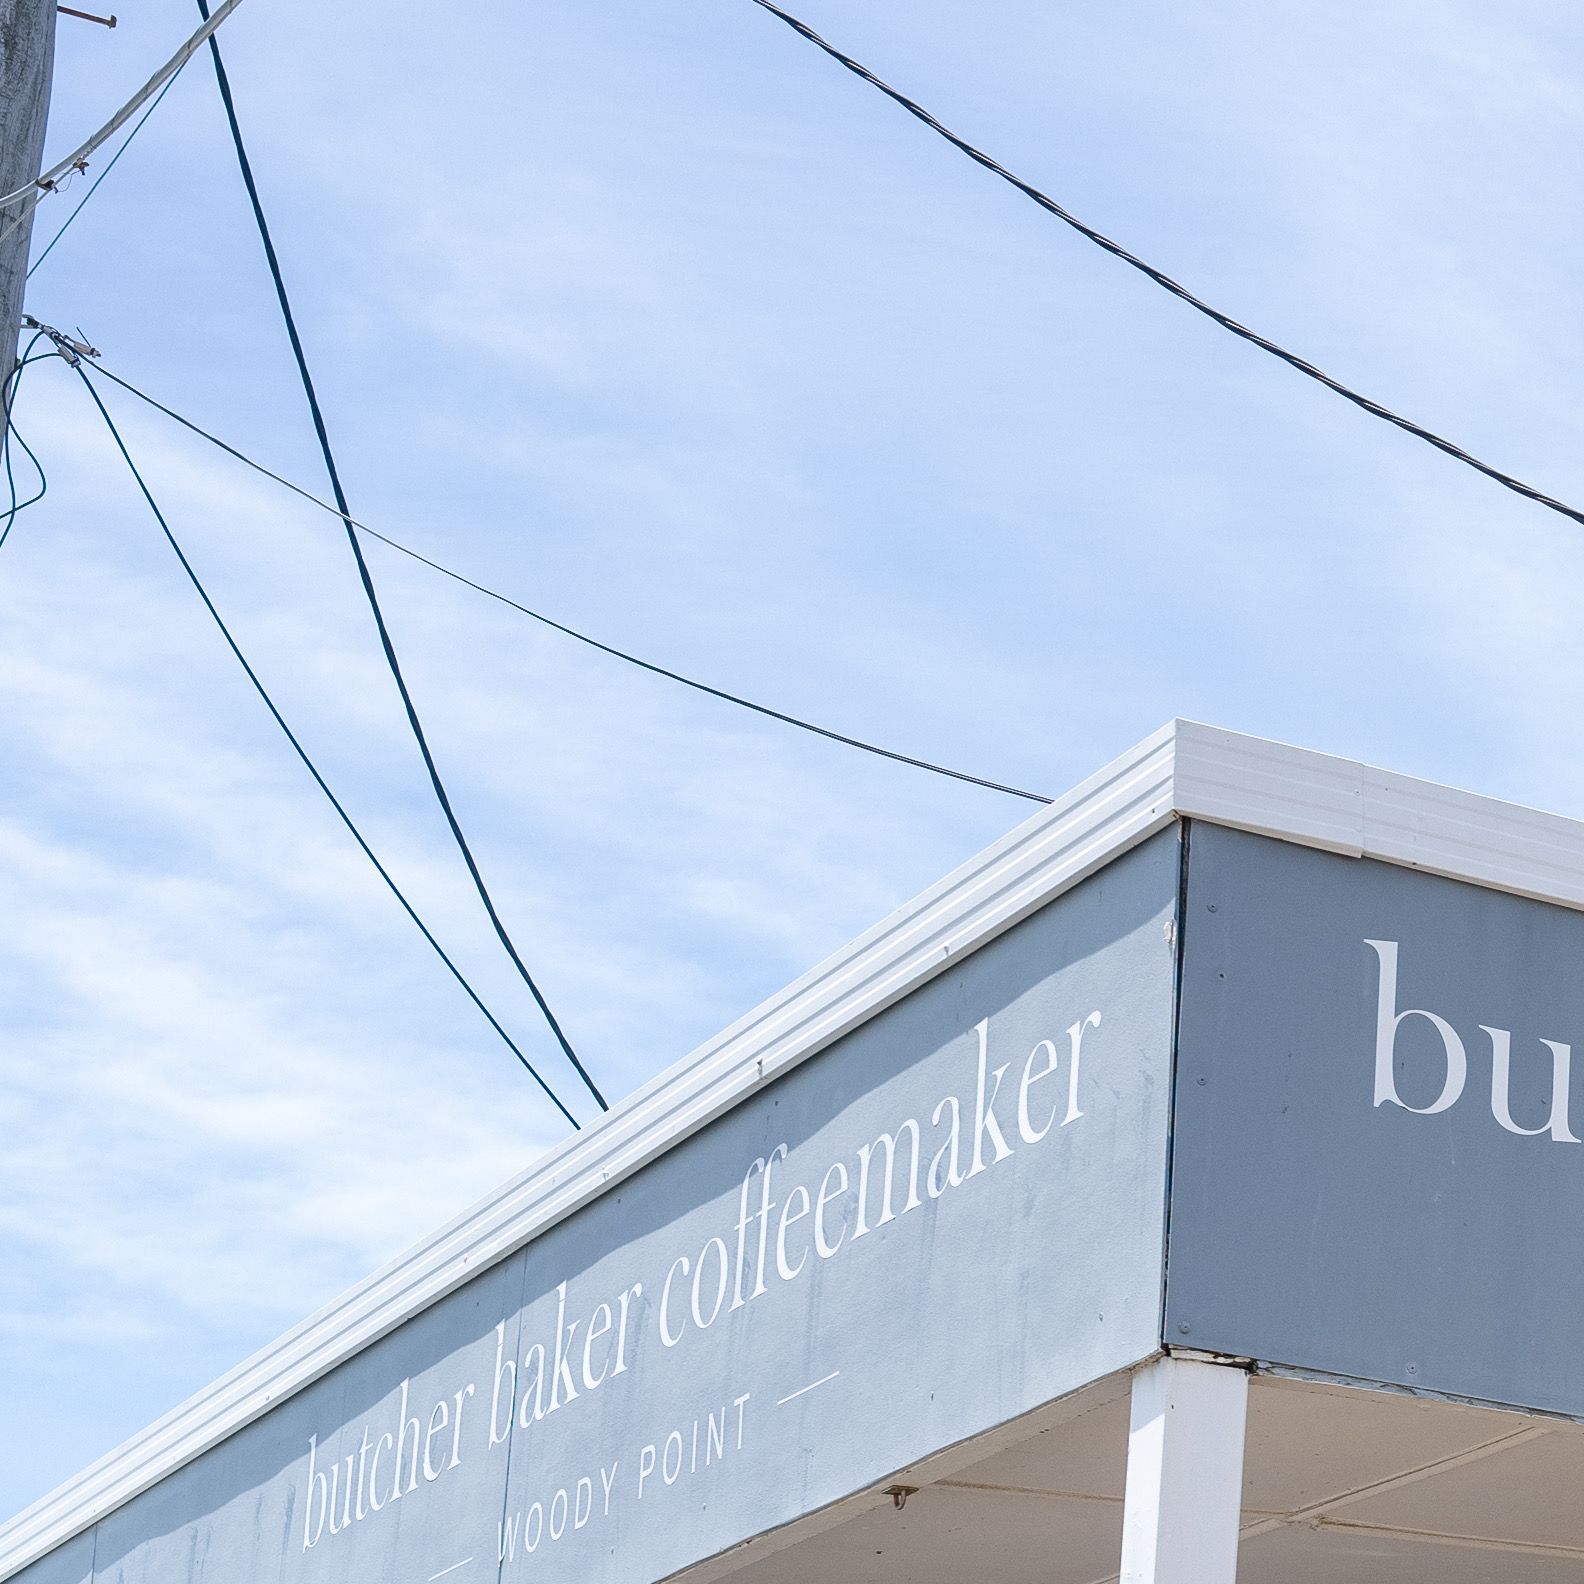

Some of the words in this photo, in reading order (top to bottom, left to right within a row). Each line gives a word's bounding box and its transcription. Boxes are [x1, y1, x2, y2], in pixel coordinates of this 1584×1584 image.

[302, 1377, 475, 1554] butcher
[488, 1280, 642, 1450] baker
[659, 1010, 1102, 1348] coffeemaker
[498, 1462, 617, 1568] WOODY
[639, 1393, 750, 1499] POINT
